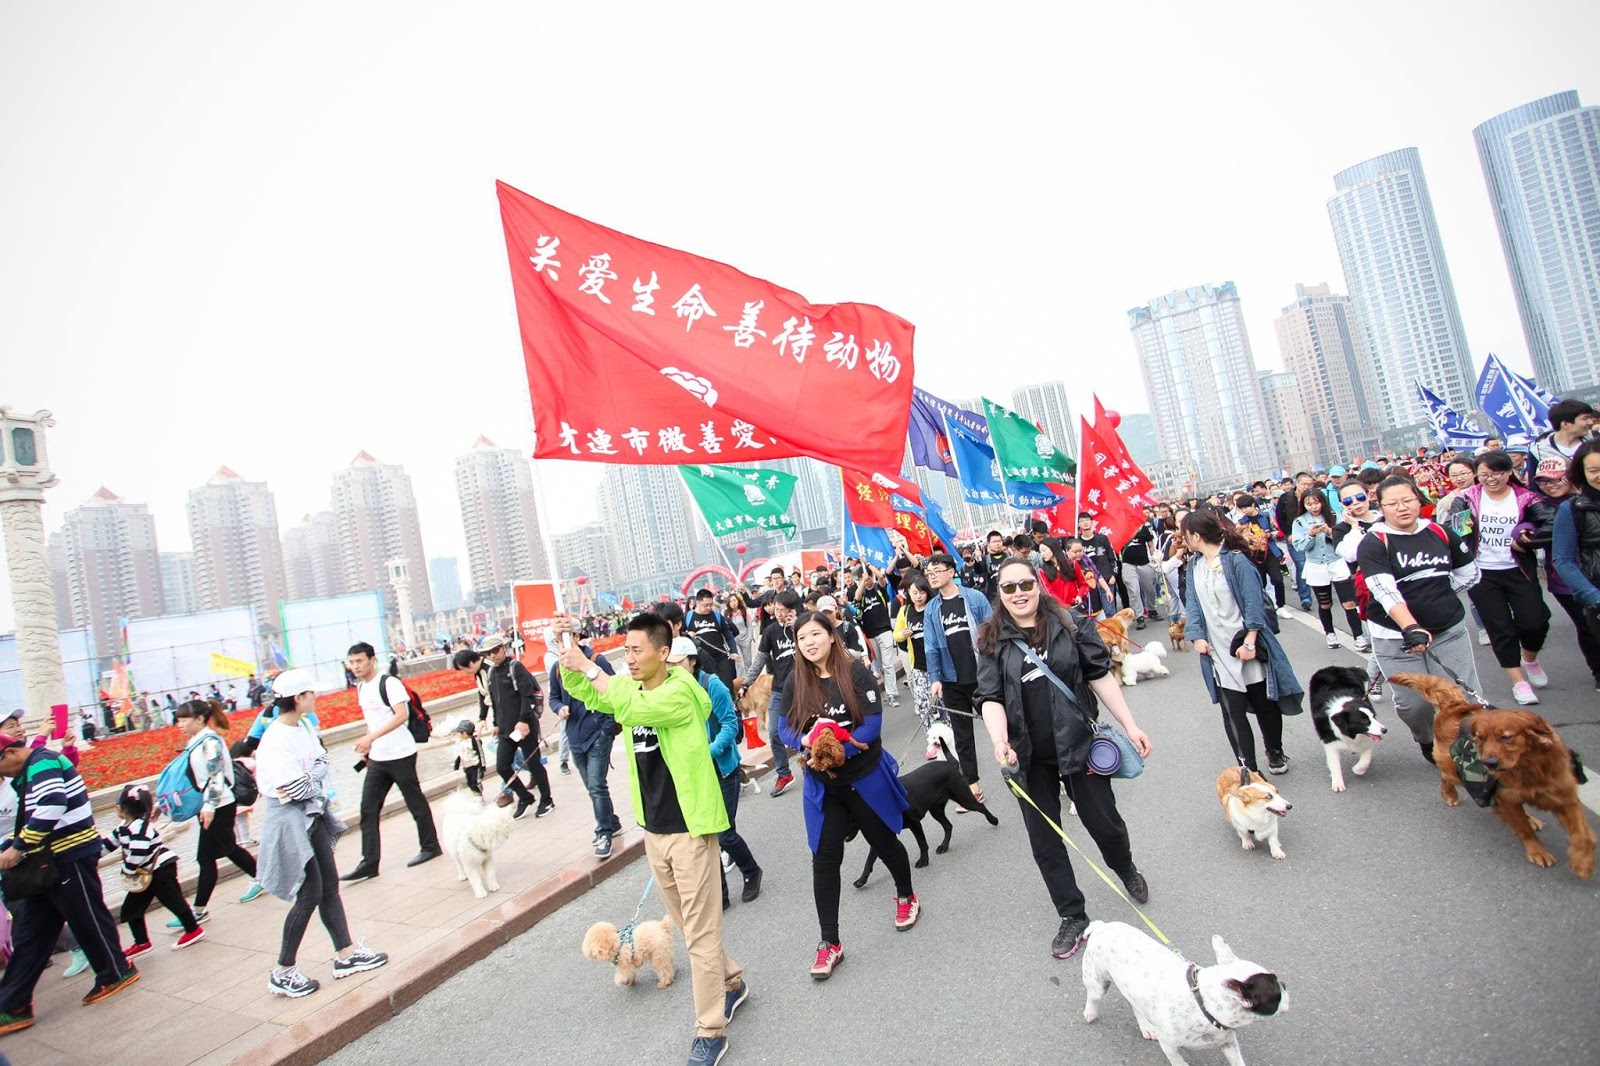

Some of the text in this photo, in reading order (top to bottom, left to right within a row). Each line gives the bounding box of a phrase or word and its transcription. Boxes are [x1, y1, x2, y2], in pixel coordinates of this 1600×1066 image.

[529, 234, 901, 384] 关爱生命善待动物
[559, 419, 777, 456] 大連市微善愛
[1480, 526, 1504, 535] AND
[1396, 551, 1450, 568] Vshine
